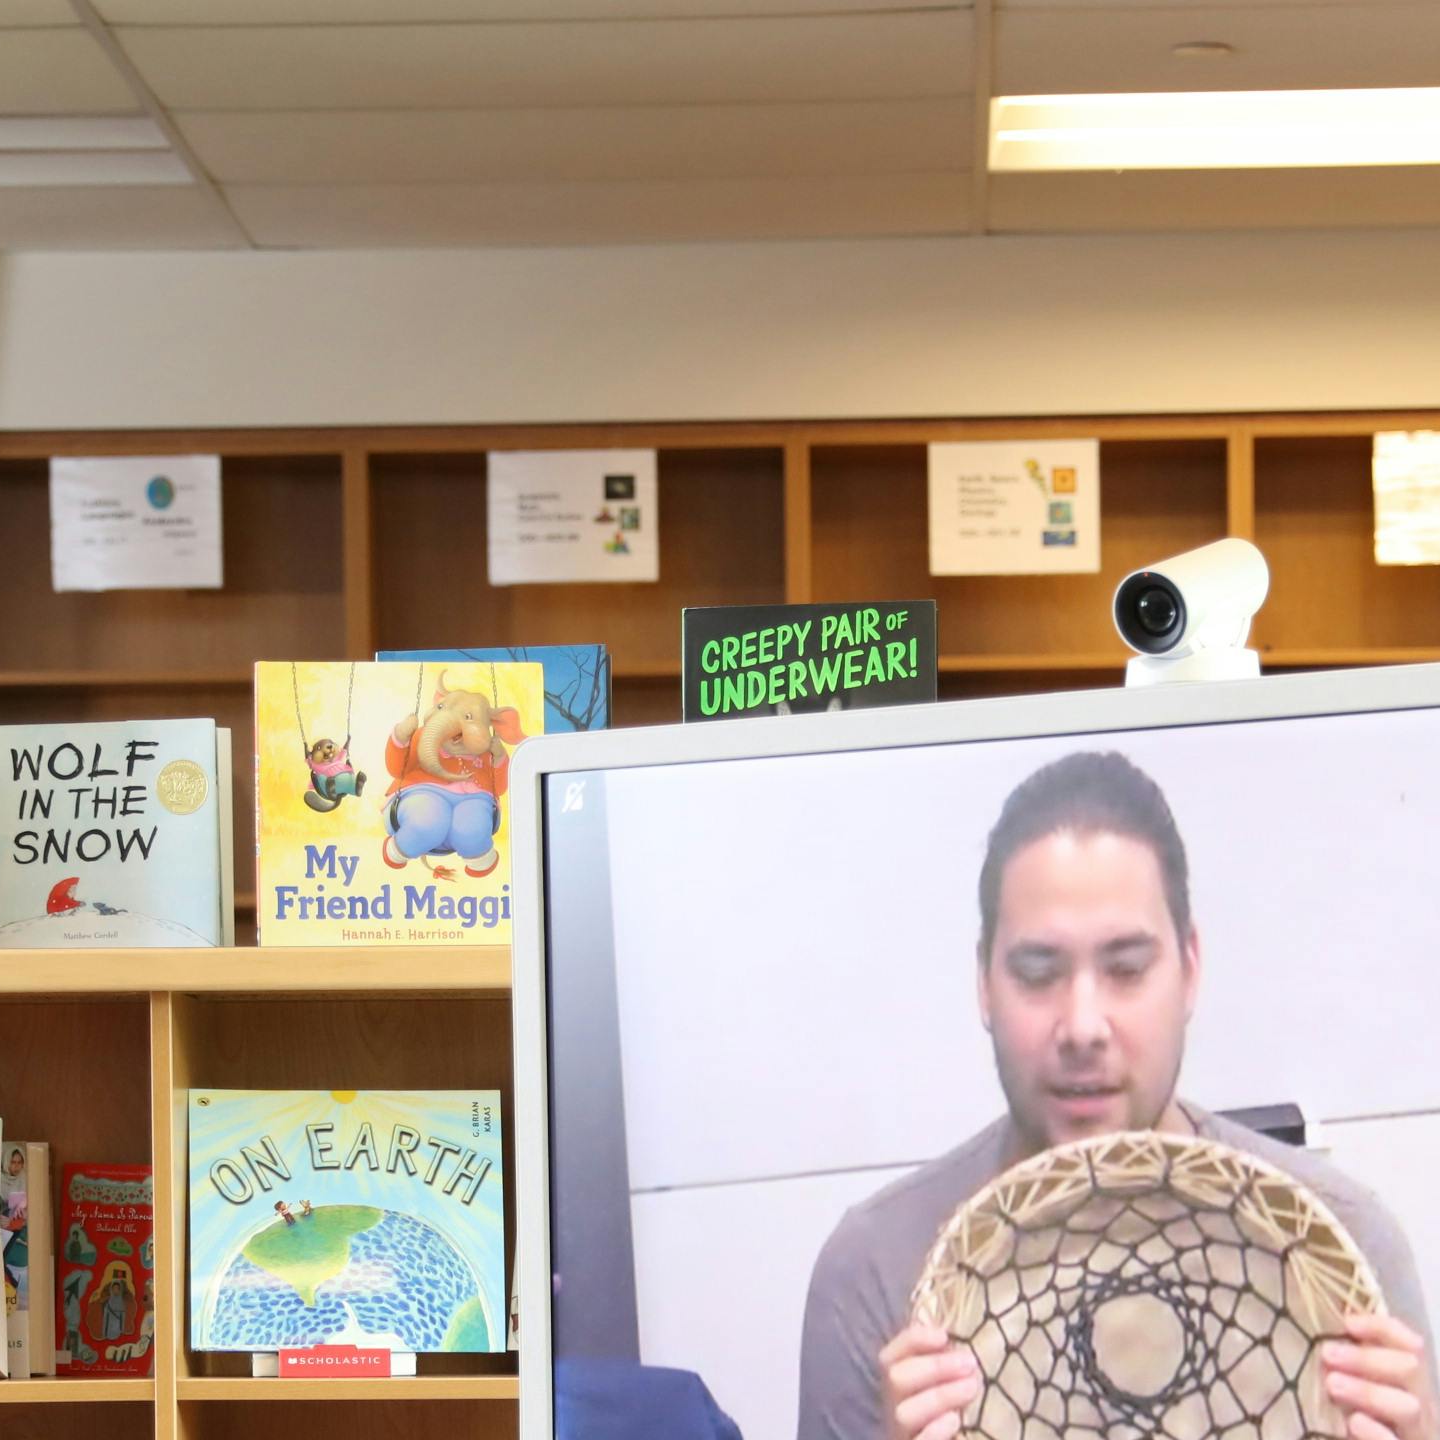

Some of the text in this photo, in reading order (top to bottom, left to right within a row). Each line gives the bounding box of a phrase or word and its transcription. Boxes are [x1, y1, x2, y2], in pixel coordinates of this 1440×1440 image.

[701, 608, 908, 673] CREEPY PAIR OF
[700, 638, 917, 715] UNDERWEAR!
[10, 740, 159, 781] WOLF
[19, 785, 147, 819] IN THE
[13, 825, 158, 864] SNOW
[304, 845, 359, 886] My
[275, 884, 511, 928] Friend Maggi
[342, 928, 391, 940] Hannah
[409, 928, 464, 940] Harrison
[473, 1129, 480, 1138] G.
[210, 1122, 492, 1205] ON EARTH
[299, 1356, 381, 1365] SCHOLASTIC
